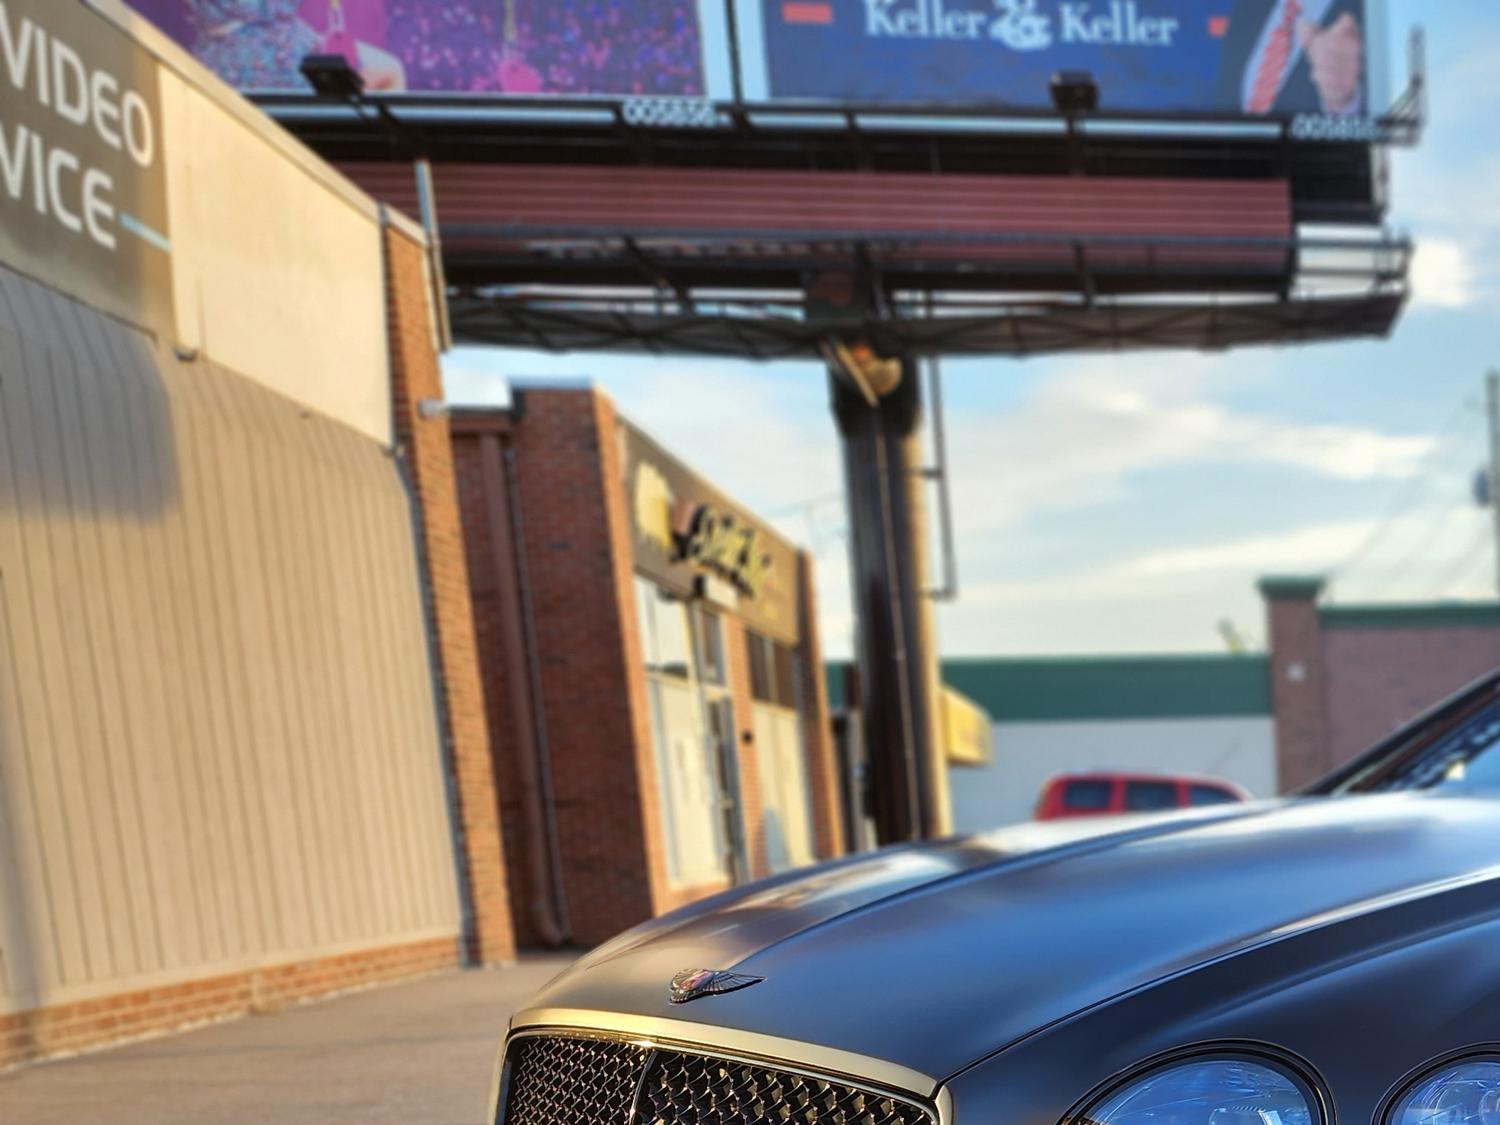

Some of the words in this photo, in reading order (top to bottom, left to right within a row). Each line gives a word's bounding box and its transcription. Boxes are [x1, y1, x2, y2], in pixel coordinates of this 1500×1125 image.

[864, 0, 987, 38] Keller
[990, 0, 1052, 50] &
[1059, 0, 1178, 45] Keller
[0, 2, 153, 167] VIDEO
